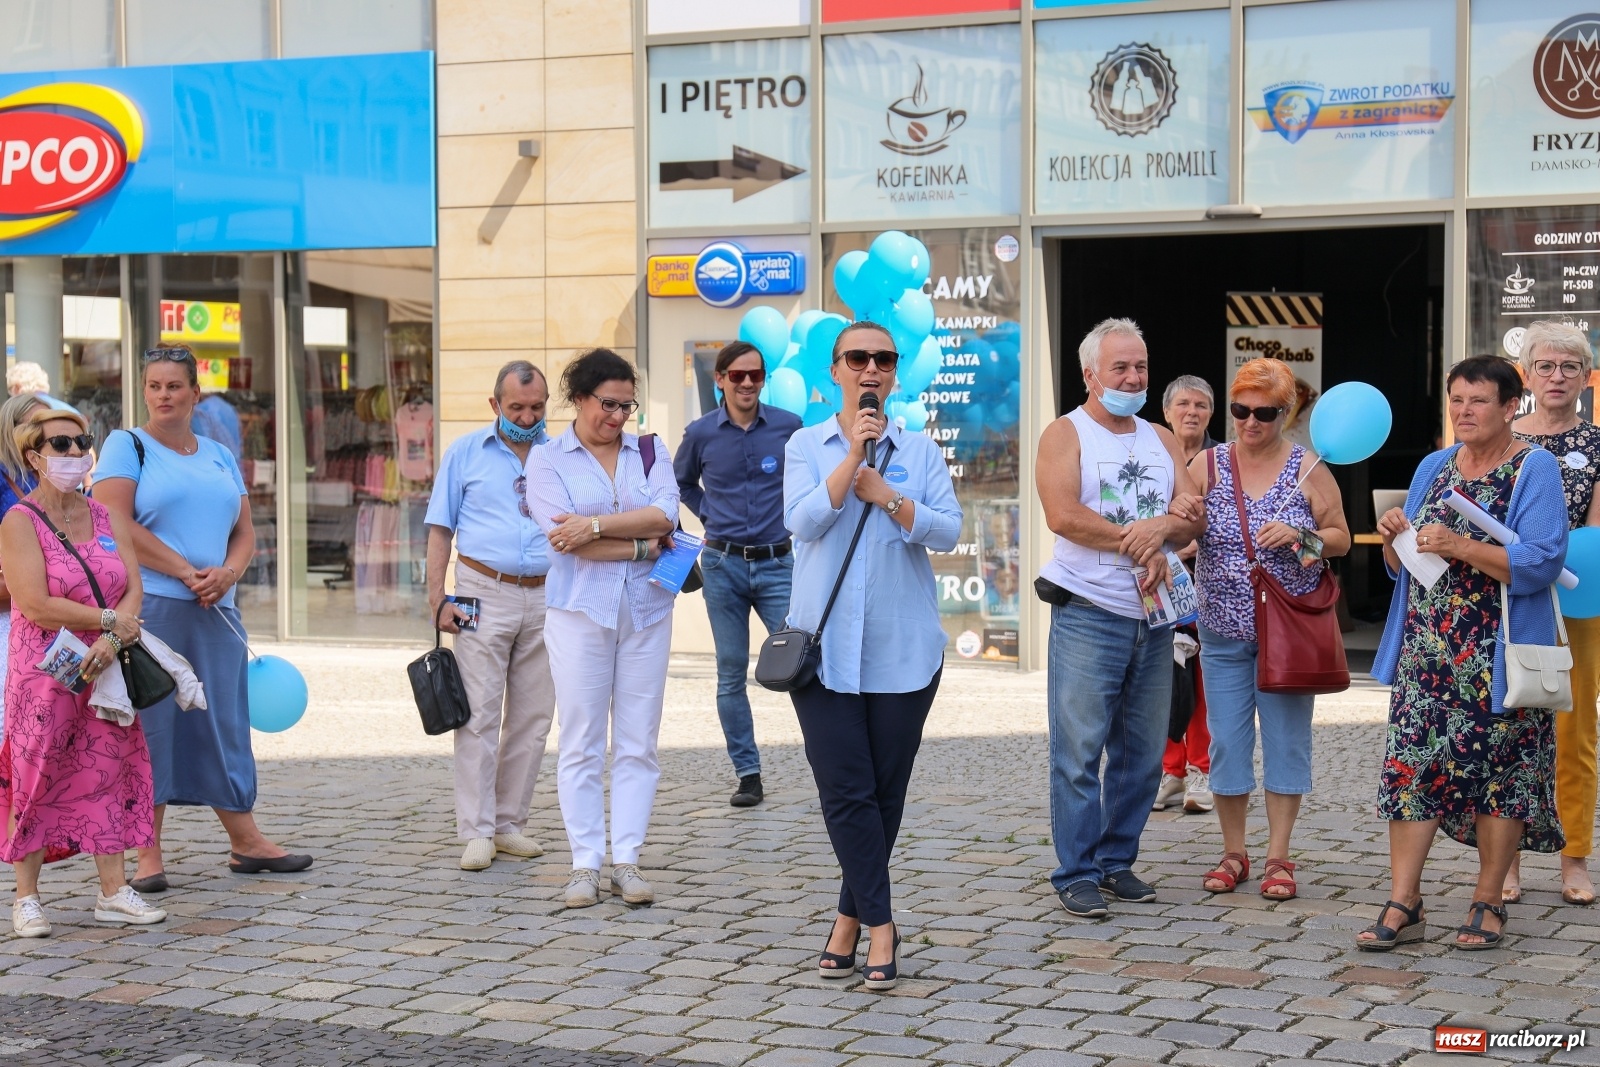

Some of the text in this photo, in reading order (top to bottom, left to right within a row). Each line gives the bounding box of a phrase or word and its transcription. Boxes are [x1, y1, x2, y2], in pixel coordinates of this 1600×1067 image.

[661, 75, 807, 118] I PIĘTRO
[1329, 82, 1450, 101] ZWROT PODATKU
[1340, 103, 1439, 122] z zagranicy
[1335, 127, 1435, 140] Anna Kłosowska
[0, 136, 98, 185] PCO
[1049, 150, 1217, 182] KOLEKCJA PROMILI
[1531, 158, 1600, 172] DAMSKO-
[877, 164, 968, 188] KOFEINKA
[889, 190, 955, 203] KAWIARNIA
[1534, 232, 1583, 245] GODZINY
[655, 260, 689, 271] banko
[749, 257, 790, 270] wpłato
[668, 271, 689, 281] mat
[766, 269, 790, 279] mat
[1563, 265, 1599, 276] PN-CZW
[1563, 280, 1594, 290] PT-SOB
[1502, 296, 1535, 304] KOFEINKA
[1563, 294, 1576, 303] ND
[935, 316, 997, 329] KANAPKI
[1234, 336, 1282, 352] Choco
[1263, 347, 1315, 362] Kebab
[931, 373, 975, 385] KOWE
[935, 574, 986, 602] RO
